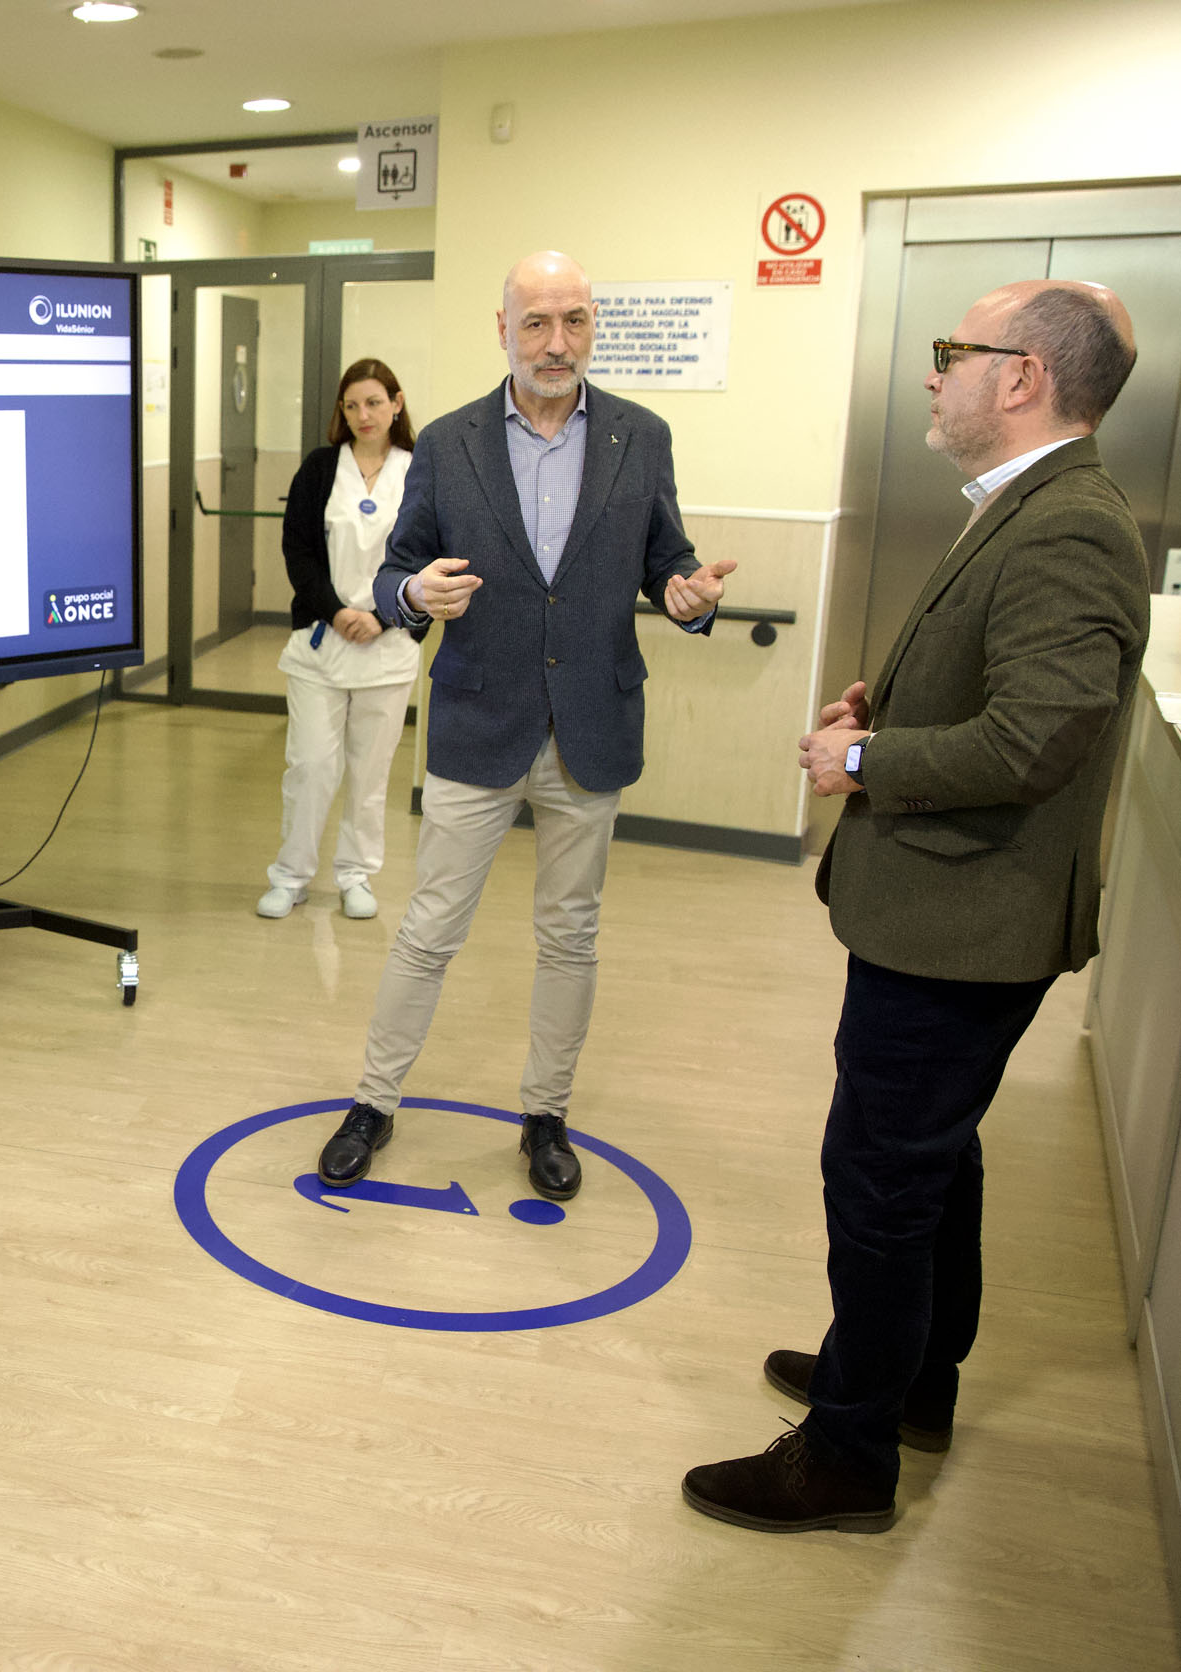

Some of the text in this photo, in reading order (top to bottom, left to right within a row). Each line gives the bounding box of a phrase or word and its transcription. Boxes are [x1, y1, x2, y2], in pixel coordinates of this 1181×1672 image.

[364, 123, 433, 138] Ascensor
[55, 303, 111, 319] ILUNION
[64, 589, 113, 606] grupo social
[64, 602, 113, 622] ONCE
